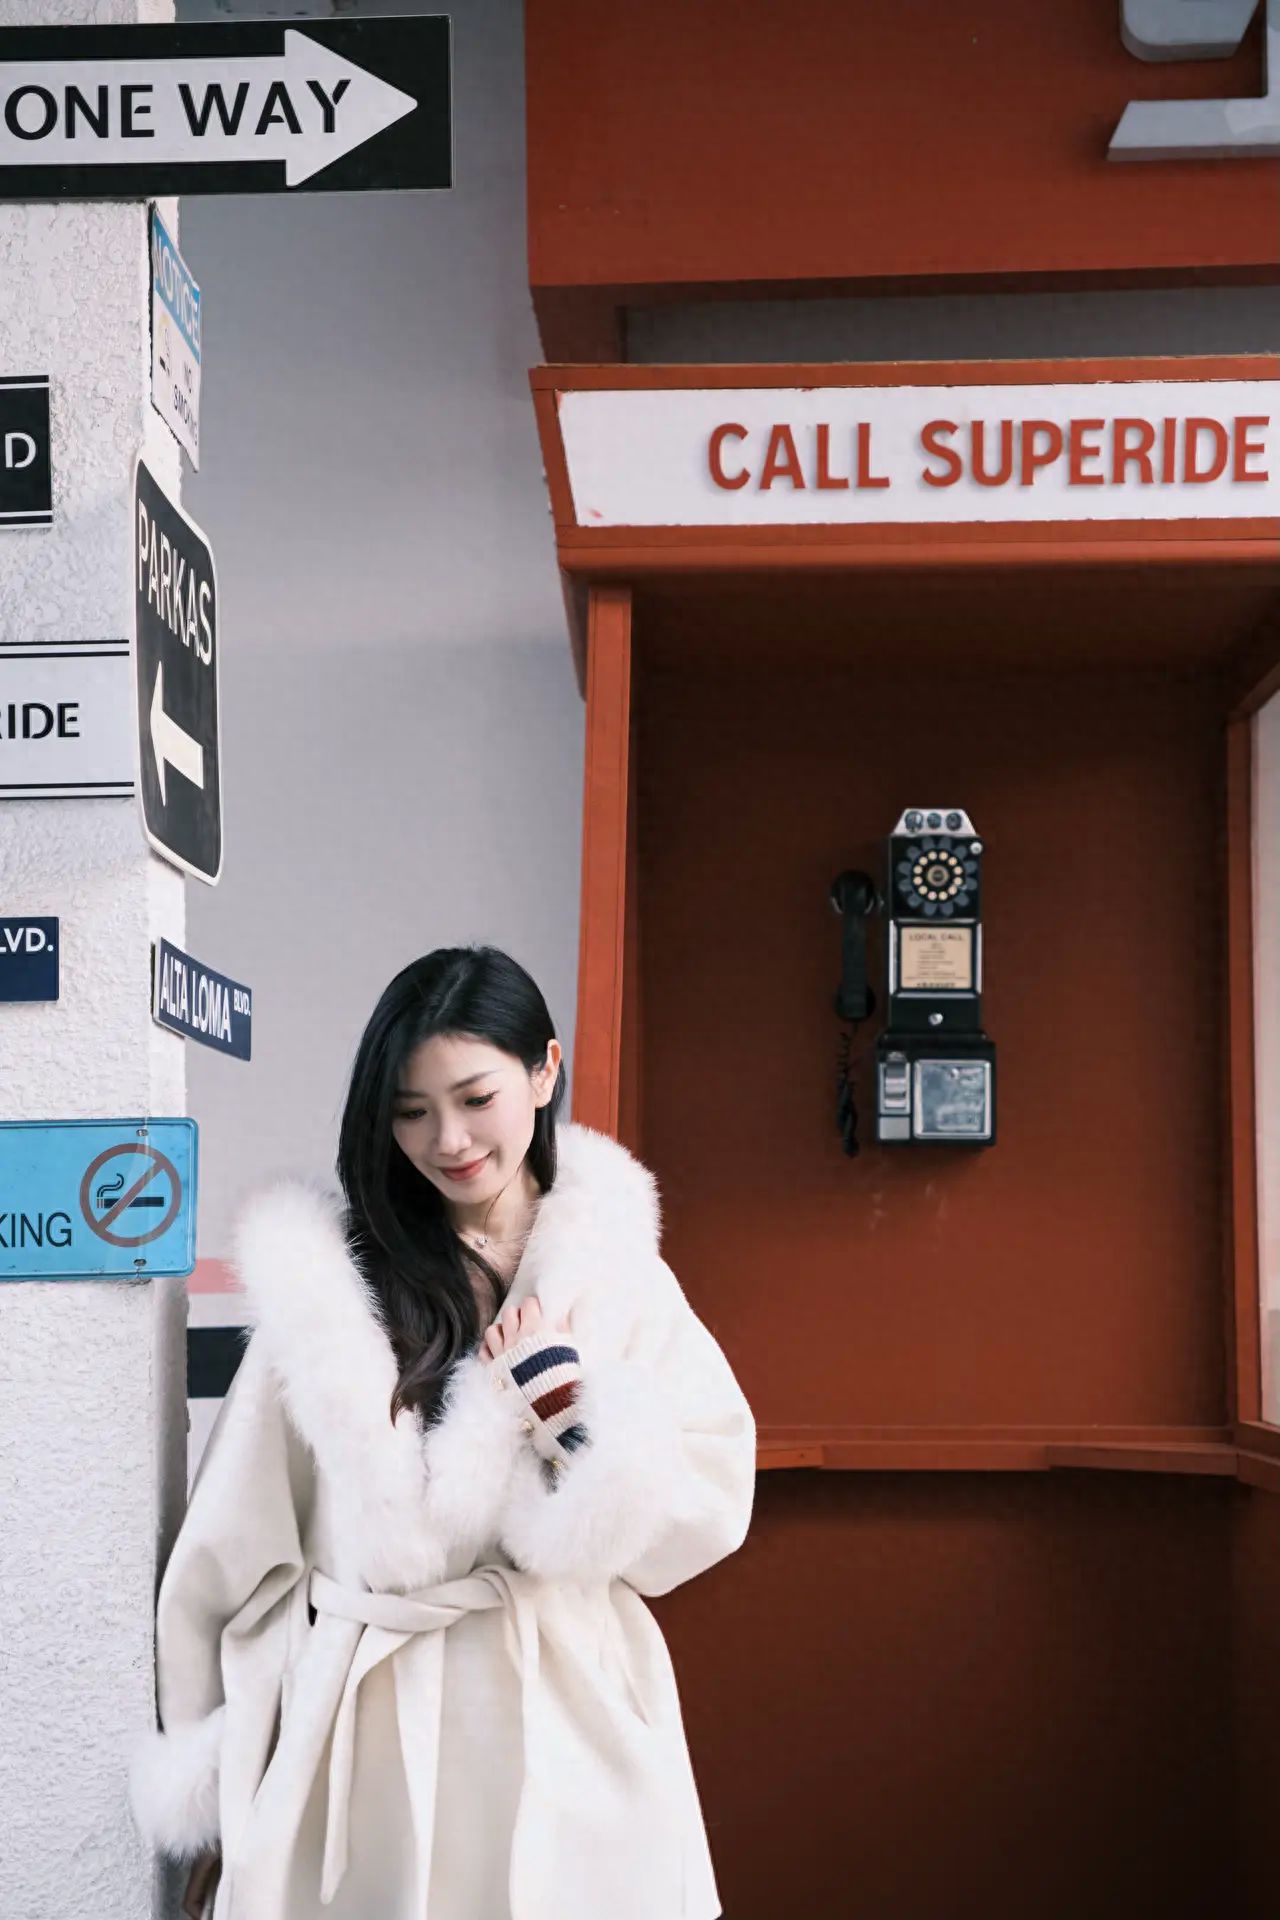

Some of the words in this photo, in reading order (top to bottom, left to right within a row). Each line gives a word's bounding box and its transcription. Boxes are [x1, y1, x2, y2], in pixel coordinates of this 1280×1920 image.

[4, 84, 155, 141] ONE
[177, 79, 352, 137] WAY
[152, 225, 200, 352] NOTICE
[5, 432, 36, 468] D
[708, 421, 890, 491] CALL
[920, 415, 1270, 487] SUPERIDE
[139, 498, 212, 666] PARKAS
[0, 703, 80, 739] IDE
[160, 952, 189, 1024] ALTA
[192, 970, 232, 1043] LOMA
[233, 988, 251, 1016] BLVD.
